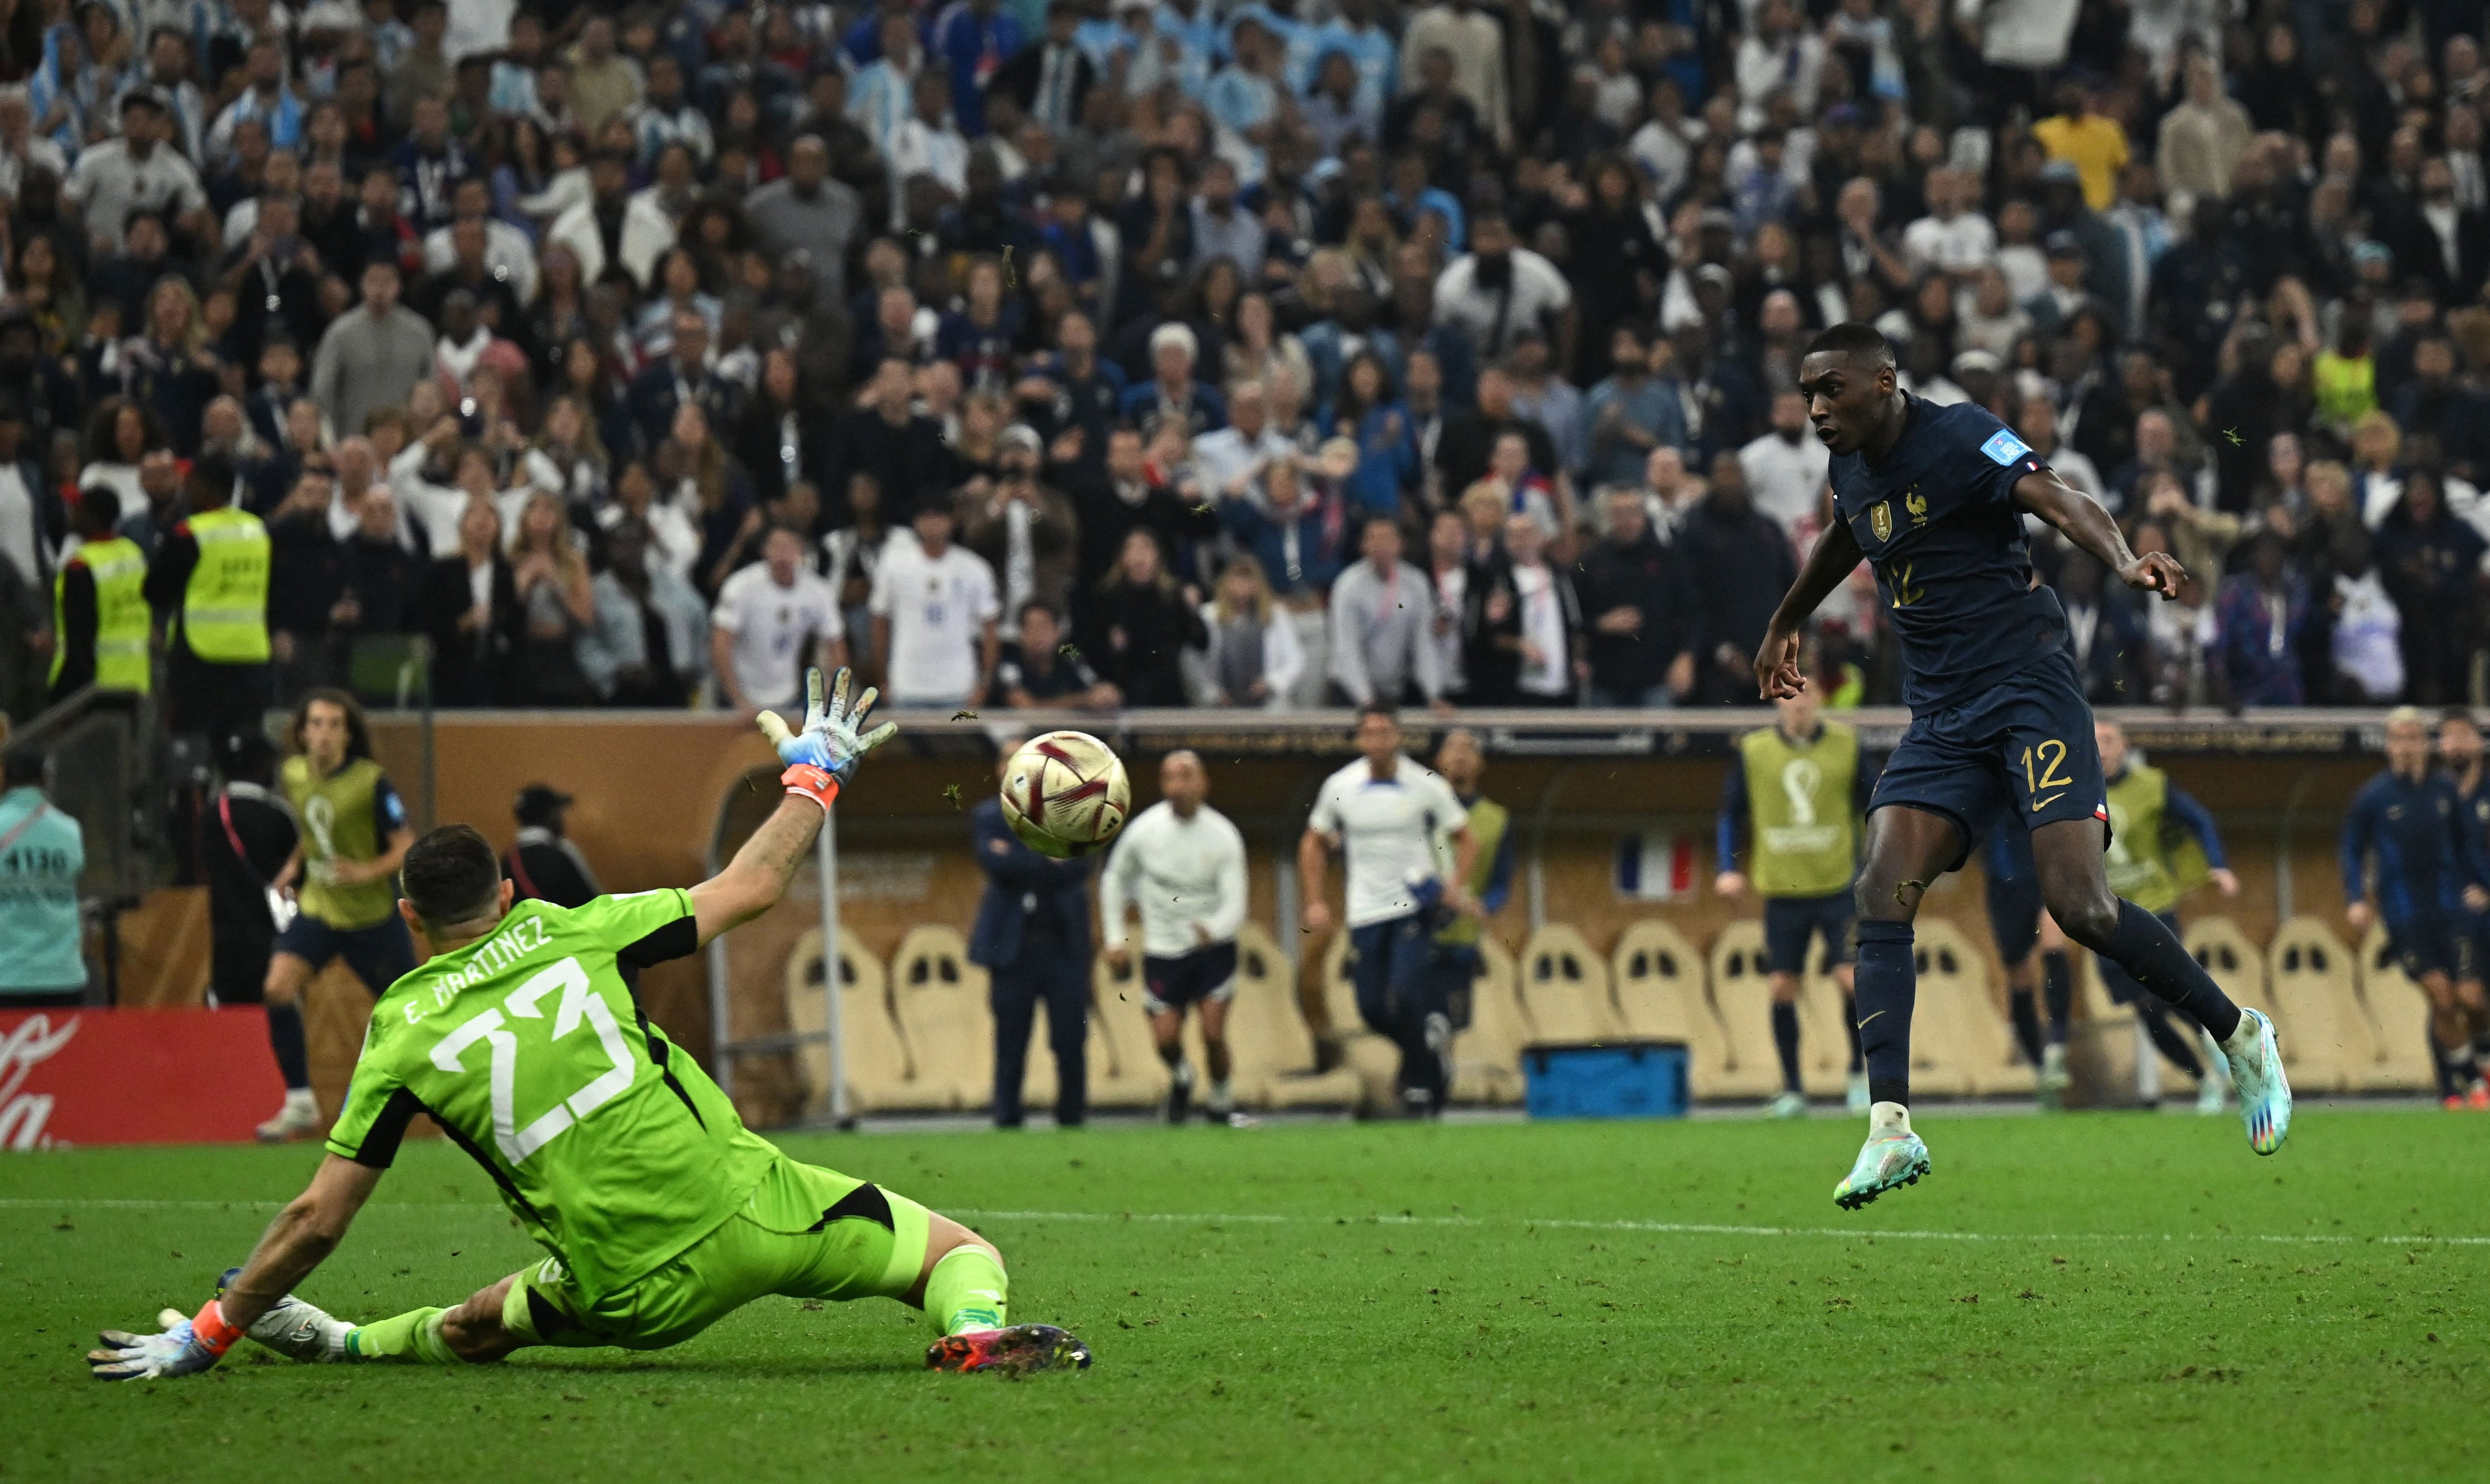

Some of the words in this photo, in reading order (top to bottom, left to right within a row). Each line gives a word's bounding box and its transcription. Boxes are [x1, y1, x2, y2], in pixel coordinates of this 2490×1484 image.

[1885, 557, 1924, 609] 12
[2021, 740, 2073, 793] 12
[403, 1000, 428, 1024] E.
[432, 915, 553, 1007] MARTINEZ
[429, 956, 635, 1166] 23
